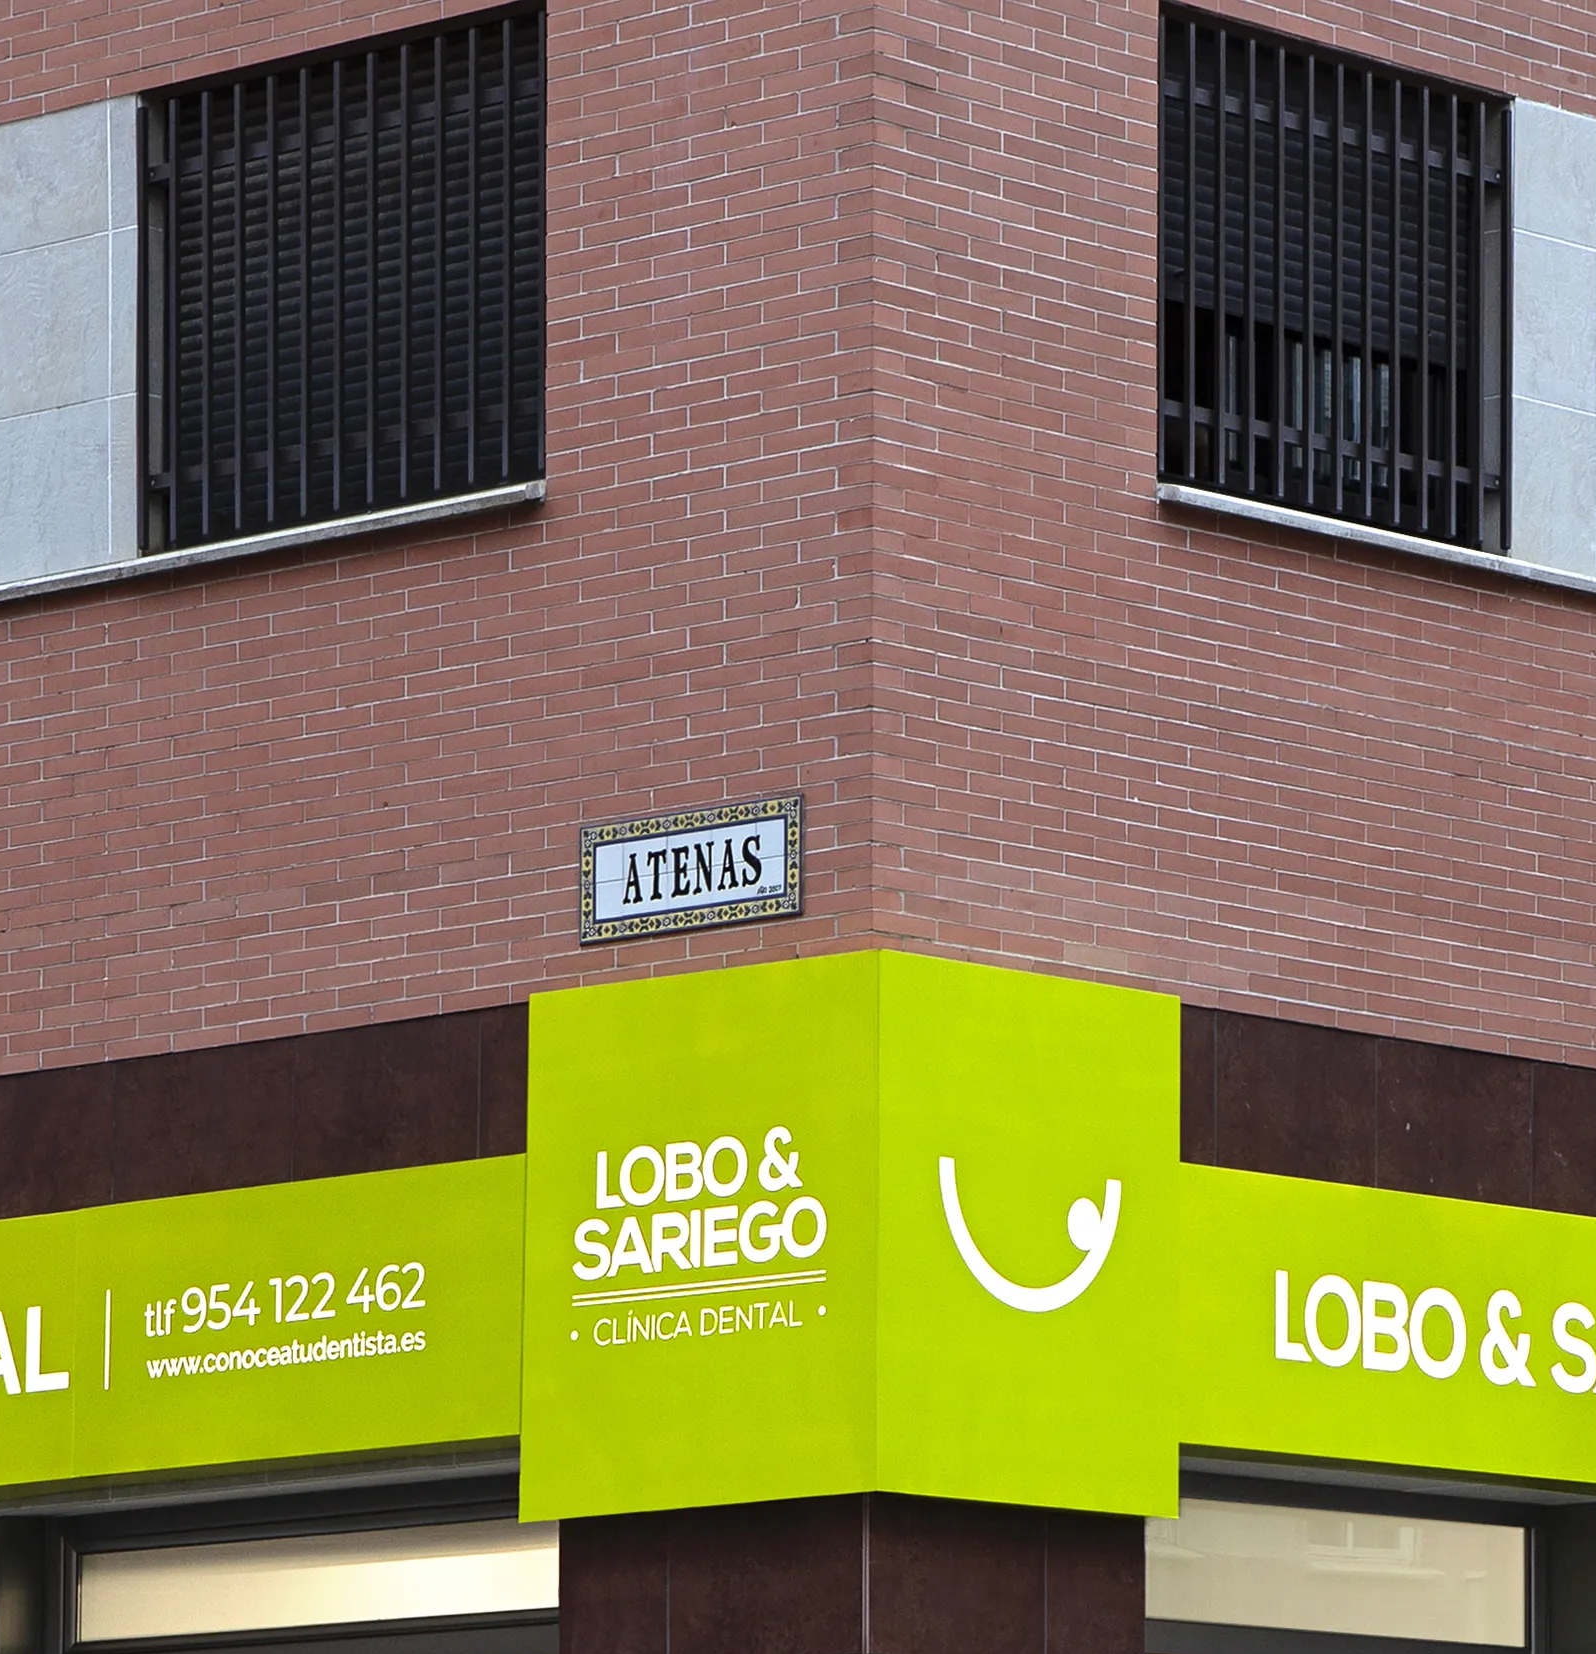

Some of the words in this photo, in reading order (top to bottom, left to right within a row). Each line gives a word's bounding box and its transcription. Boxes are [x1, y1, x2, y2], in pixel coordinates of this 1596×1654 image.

[622, 834, 762, 905] ATENAS
[595, 1136, 748, 1210] LOBO
[757, 1126, 803, 1192] &
[572, 1196, 827, 1281] SARIEGO
[144, 1298, 177, 1338] tlf
[181, 1281, 261, 1334] 954
[268, 1272, 336, 1324] 122
[345, 1261, 426, 1314] 462
[593, 1311, 693, 1347] CLÍNICA
[699, 1301, 803, 1337] DENTAL
[1274, 1269, 1467, 1379] LOBO
[1479, 1289, 1537, 1388] &
[146, 1330, 426, 1379] www.conoceatudentista.es
